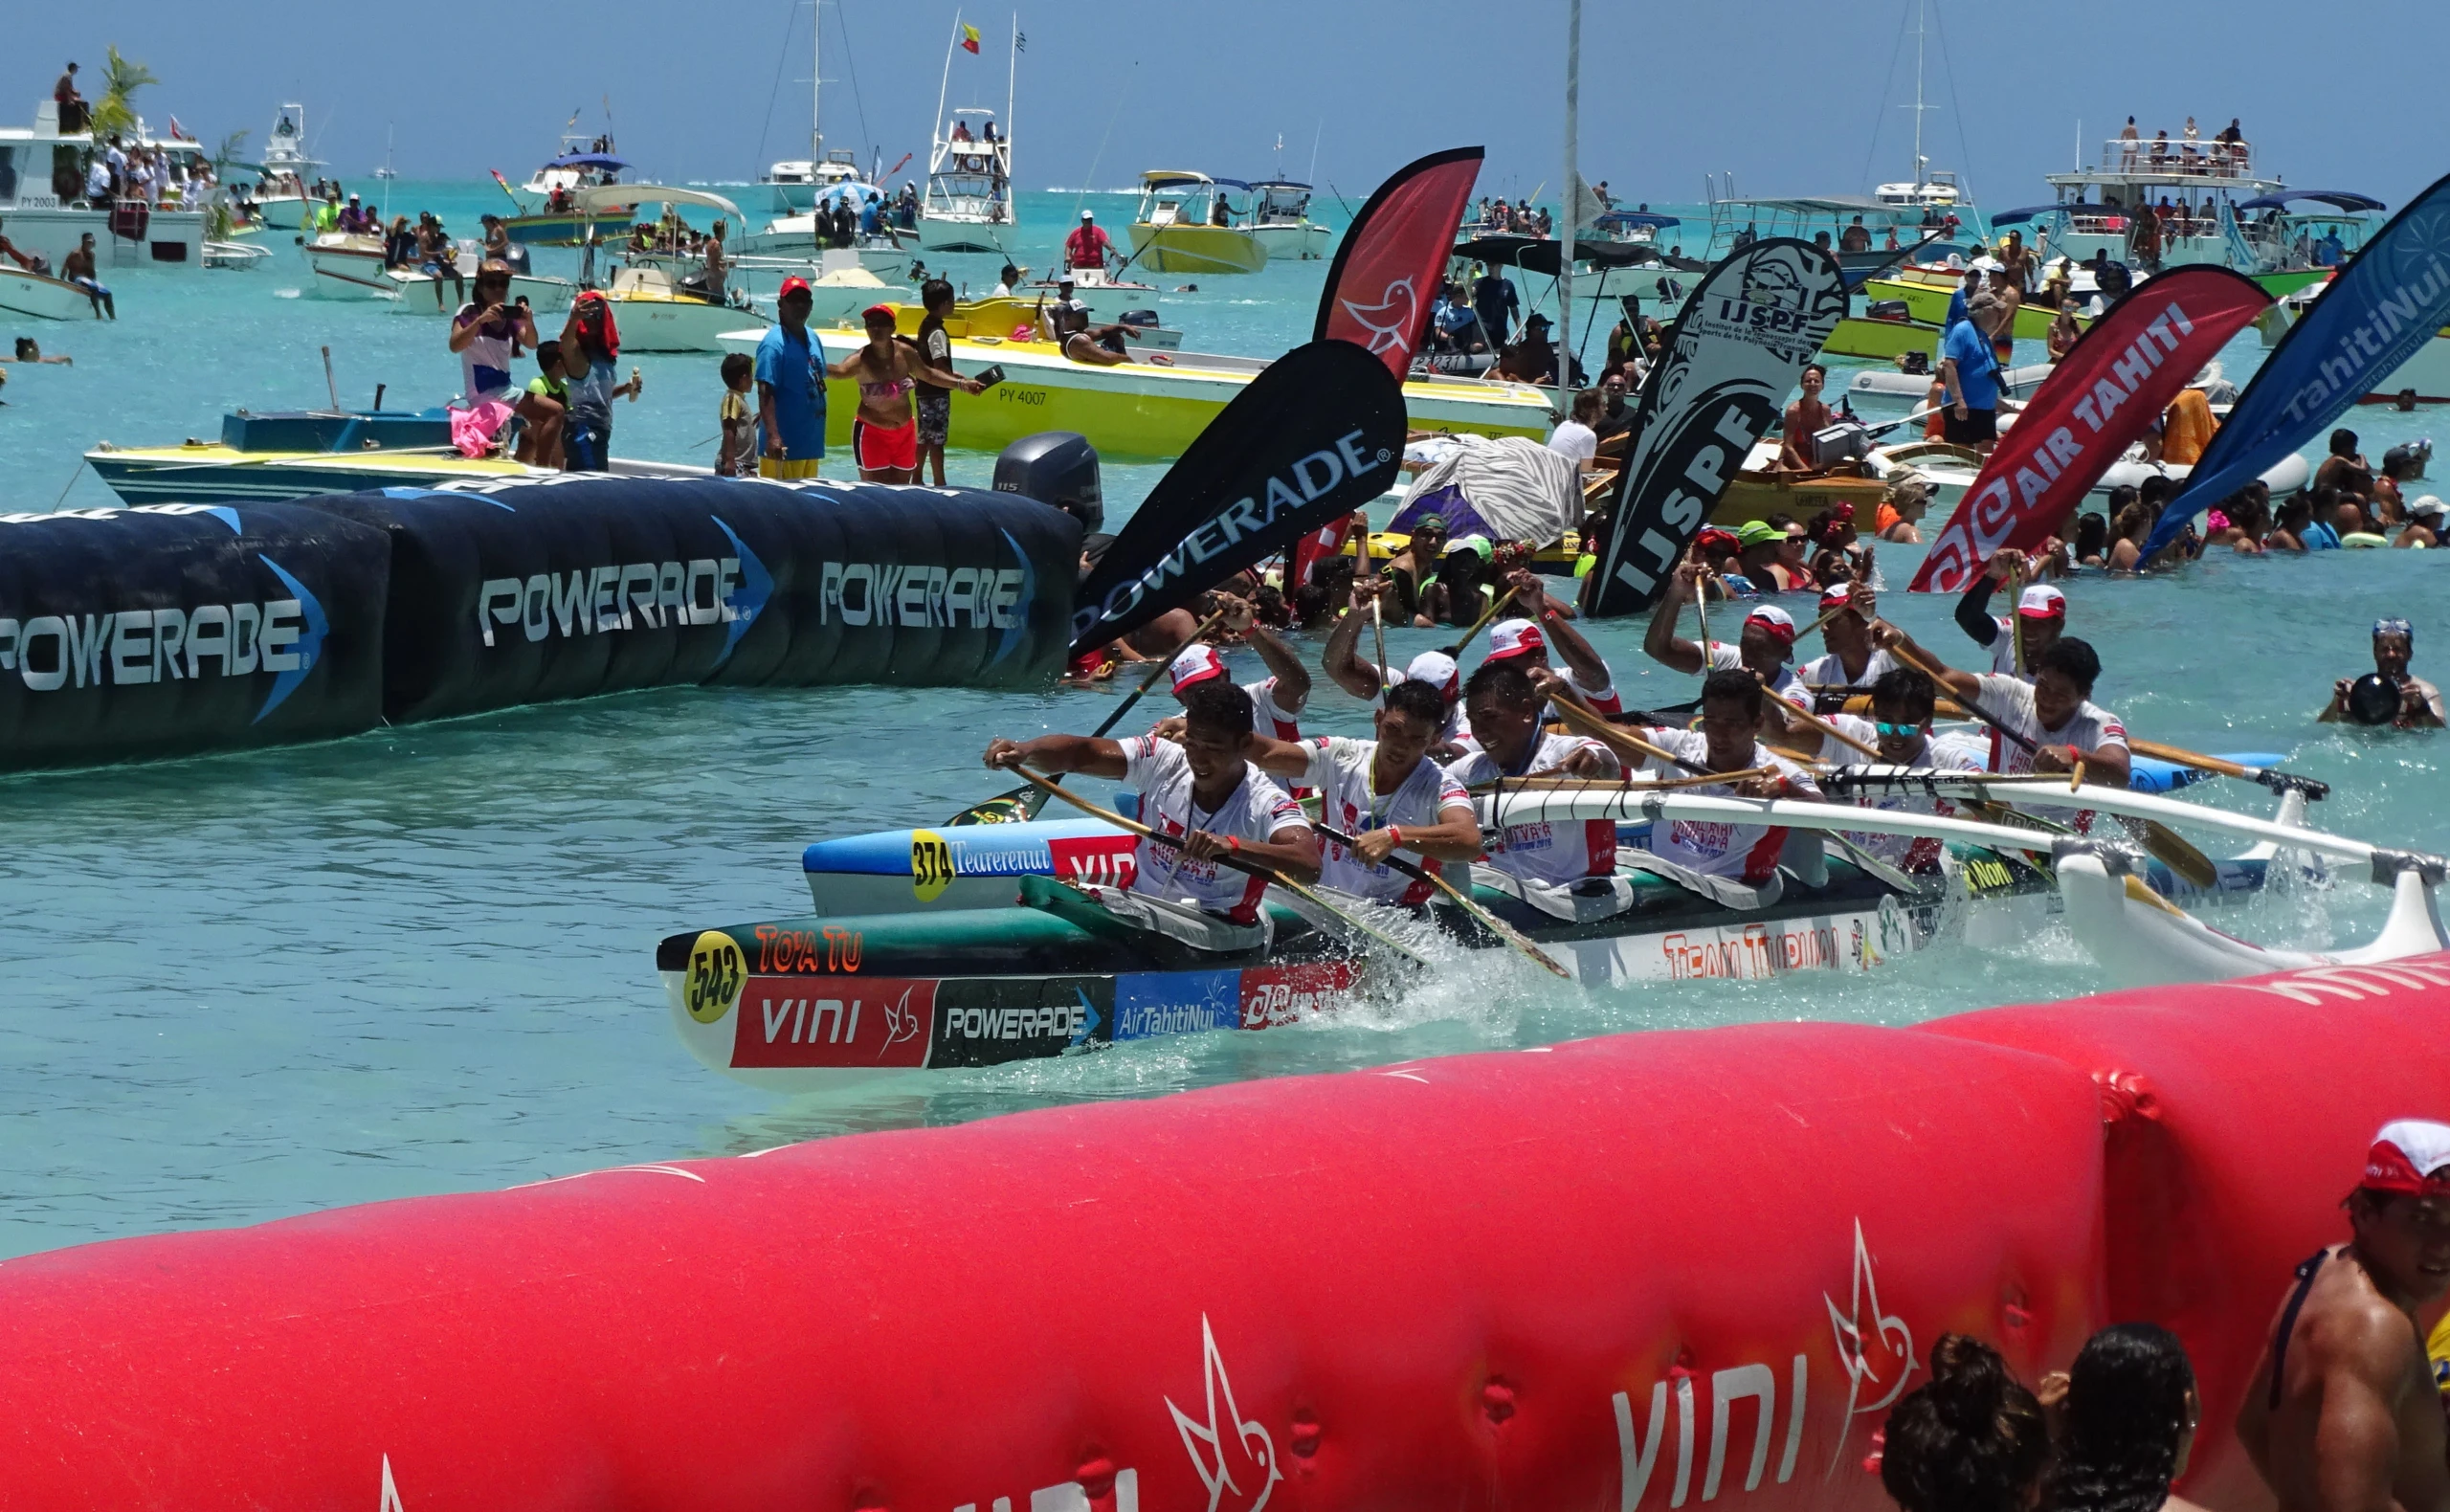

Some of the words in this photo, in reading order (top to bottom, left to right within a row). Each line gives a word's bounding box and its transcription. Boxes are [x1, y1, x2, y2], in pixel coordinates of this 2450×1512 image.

[21, 197, 33, 208] PY
[34, 197, 56, 208] 2003
[1698, 326, 1722, 337] Sports
[1704, 320, 1732, 331] Institut
[1719, 299, 1810, 335] IJSPF
[2282, 253, 2450, 422] TahitiNui
[999, 388, 1015, 402] PY
[1017, 390, 1046, 406] 4007
[2016, 426, 2084, 510] AIR
[2072, 301, 2195, 433] TAHITI
[997, 481, 1018, 492] 115
[1616, 403, 1756, 597] IJSPF
[1069, 429, 1380, 647] POWERADE
[479, 558, 741, 647] POWERADE
[820, 562, 1025, 629] POWERADE
[913, 841, 953, 886] 374
[822, 925, 862, 973] TU
[1663, 933, 1742, 980] TEAM
[691, 945, 740, 1012] 543
[762, 999, 862, 1044] VINI
[945, 1005, 1086, 1040] POWERADE
[1613, 1353, 1808, 1512] VINI
